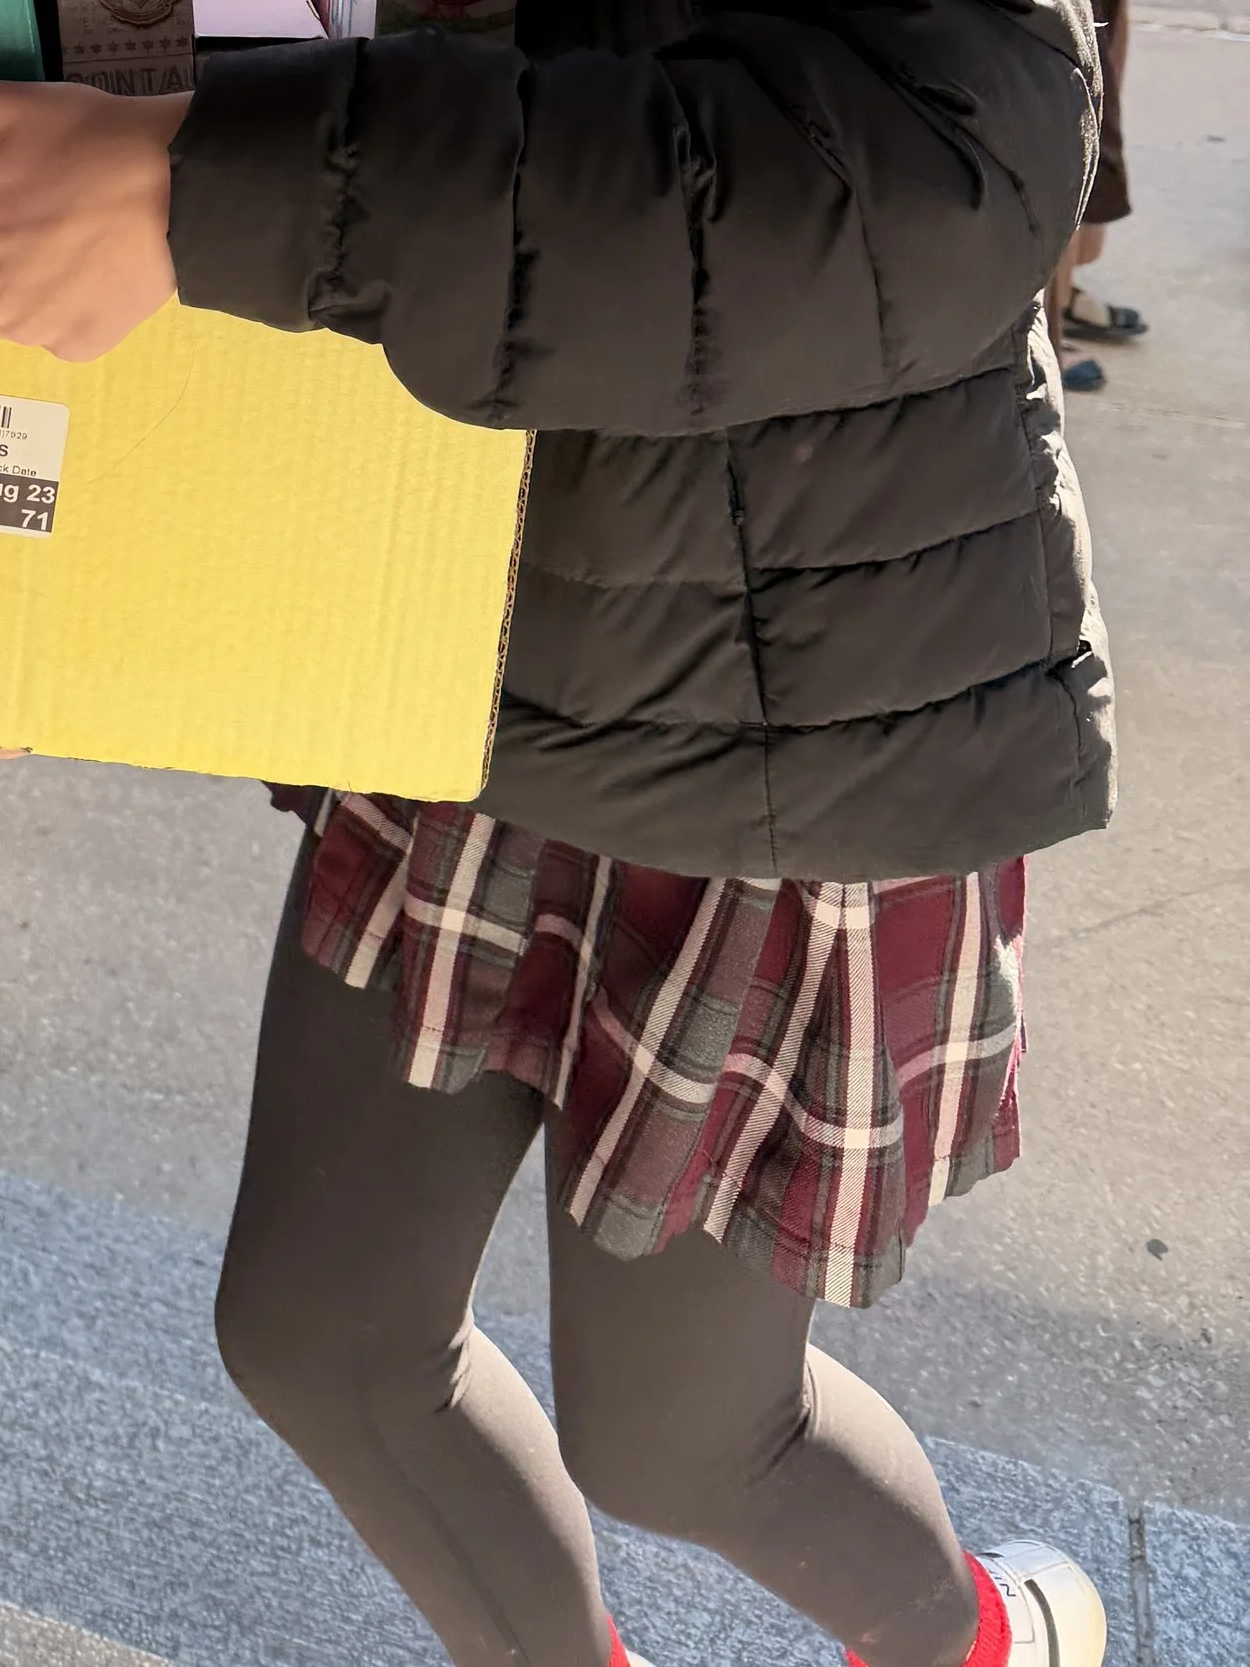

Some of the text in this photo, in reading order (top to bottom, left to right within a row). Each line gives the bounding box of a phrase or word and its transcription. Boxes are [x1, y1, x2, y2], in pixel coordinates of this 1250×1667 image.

[12, 465, 37, 477] Date
[26, 484, 55, 504] 23
[21, 509, 49, 531] 71
